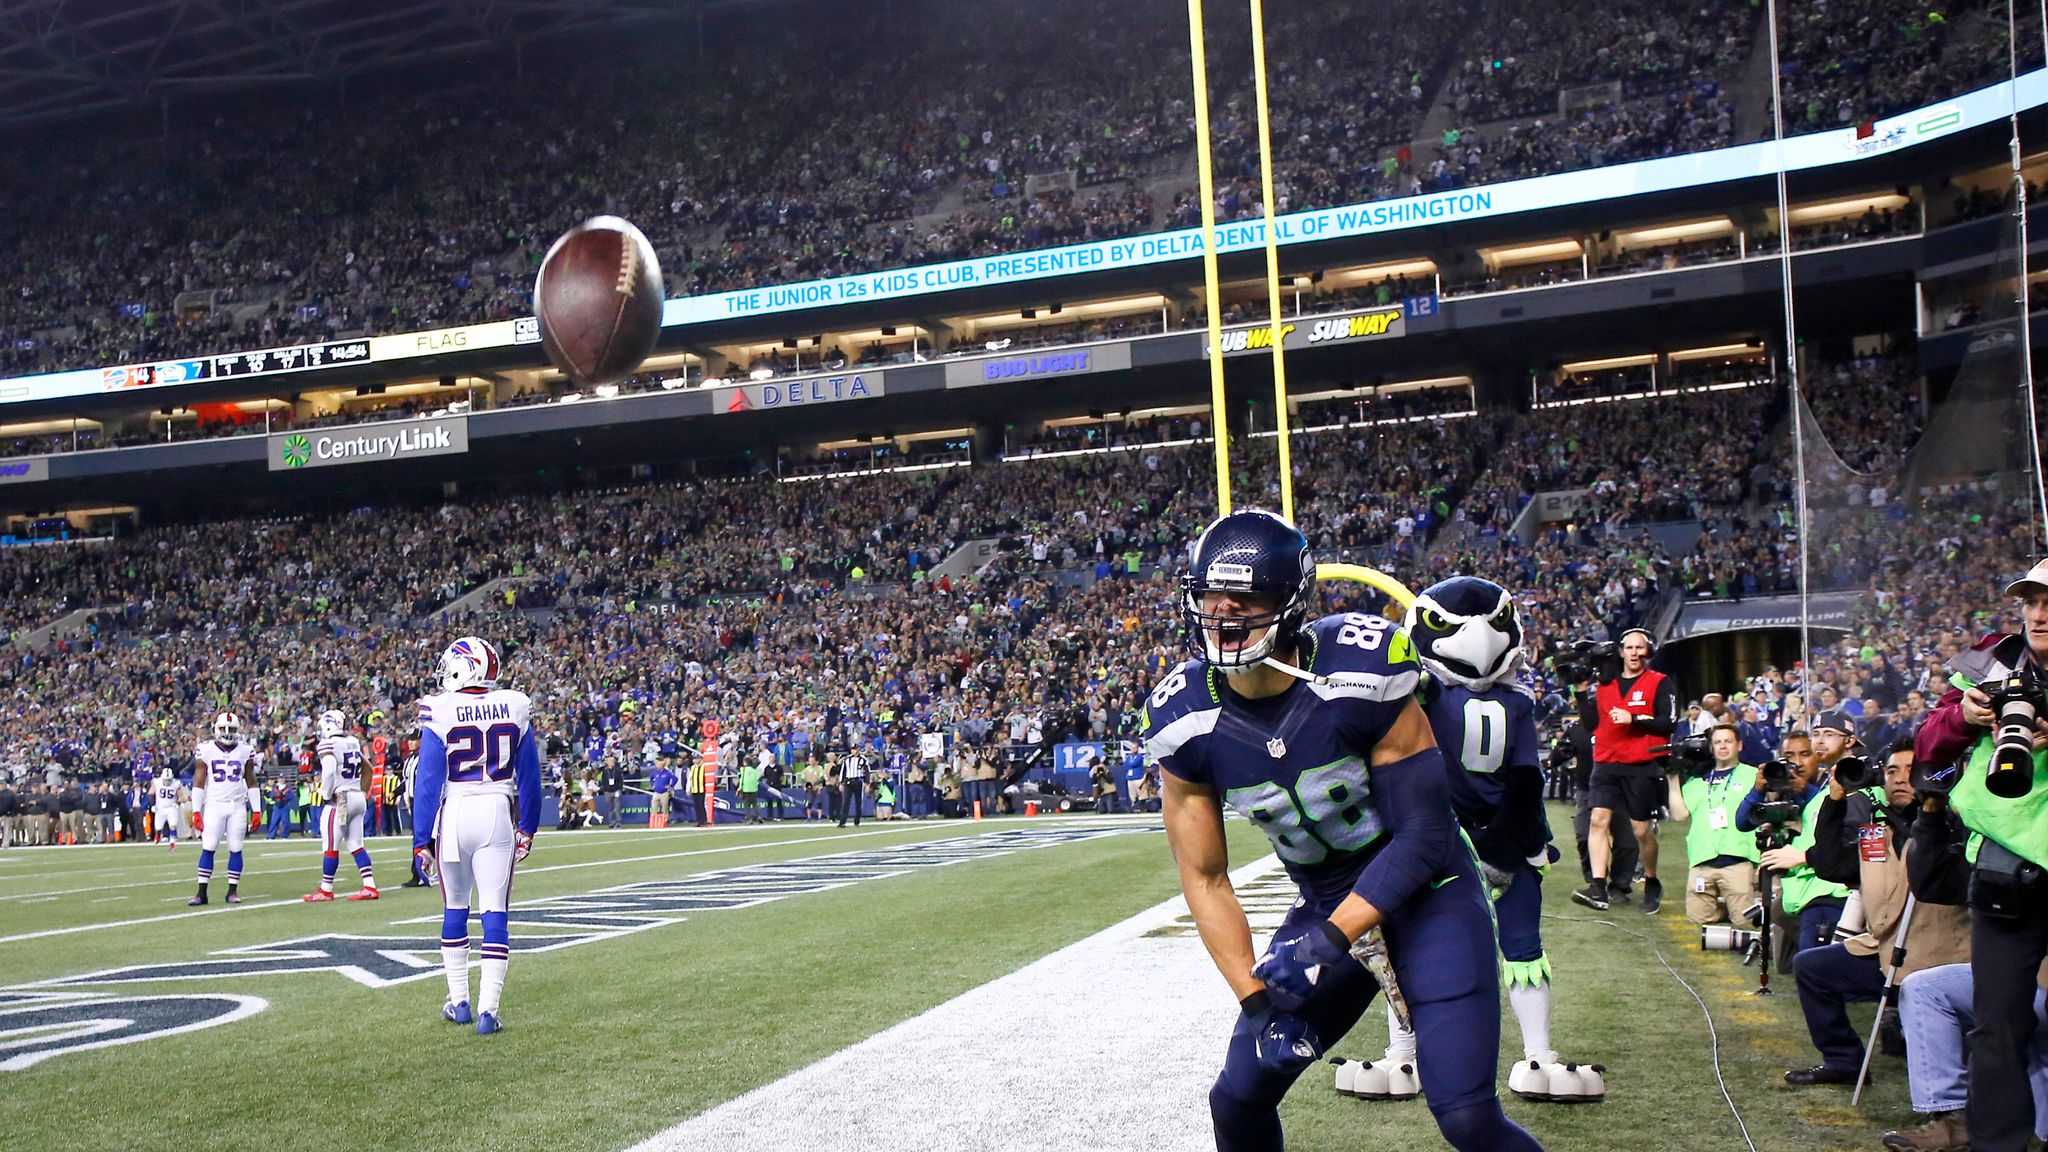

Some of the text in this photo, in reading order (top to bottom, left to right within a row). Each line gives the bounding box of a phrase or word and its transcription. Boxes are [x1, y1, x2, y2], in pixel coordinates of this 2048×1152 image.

[725, 293, 761, 312] THE
[766, 284, 832, 308] JUNIOR
[838, 281, 867, 299] 12s
[873, 272, 919, 294] KIDS
[925, 264, 980, 288] CLUB,
[985, 248, 1104, 280] PRESENTED
[1111, 243, 1136, 262] BY
[1142, 235, 1205, 258] DELTA
[1302, 215, 1329, 236] OF
[1337, 191, 1491, 231] WASHINGTON
[1409, 297, 1432, 316] 12
[1308, 311, 1400, 342] SUBWAY
[417, 331, 467, 351] FLAG
[192, 361, 203, 377] 7
[224, 364, 232, 376] 1
[248, 361, 264, 373] 10
[280, 357, 296, 370] 17
[312, 355, 322, 366] 2
[983, 350, 1088, 380] BUD LIGHT
[130, 367, 150, 384] 14
[762, 374, 871, 407] DELTA
[316, 425, 452, 460] CenturyLink
[1336, 612, 1390, 651] 88
[1329, 682, 1378, 691] SEAHAWKS
[456, 703, 510, 722] GRAHAM
[1460, 698, 1507, 773] 0
[446, 722, 520, 782] 20
[1062, 745, 1097, 769] 12
[211, 759, 242, 783] 53
[341, 751, 362, 779] 52
[159, 788, 175, 800] 95
[1226, 755, 1387, 865] 88
